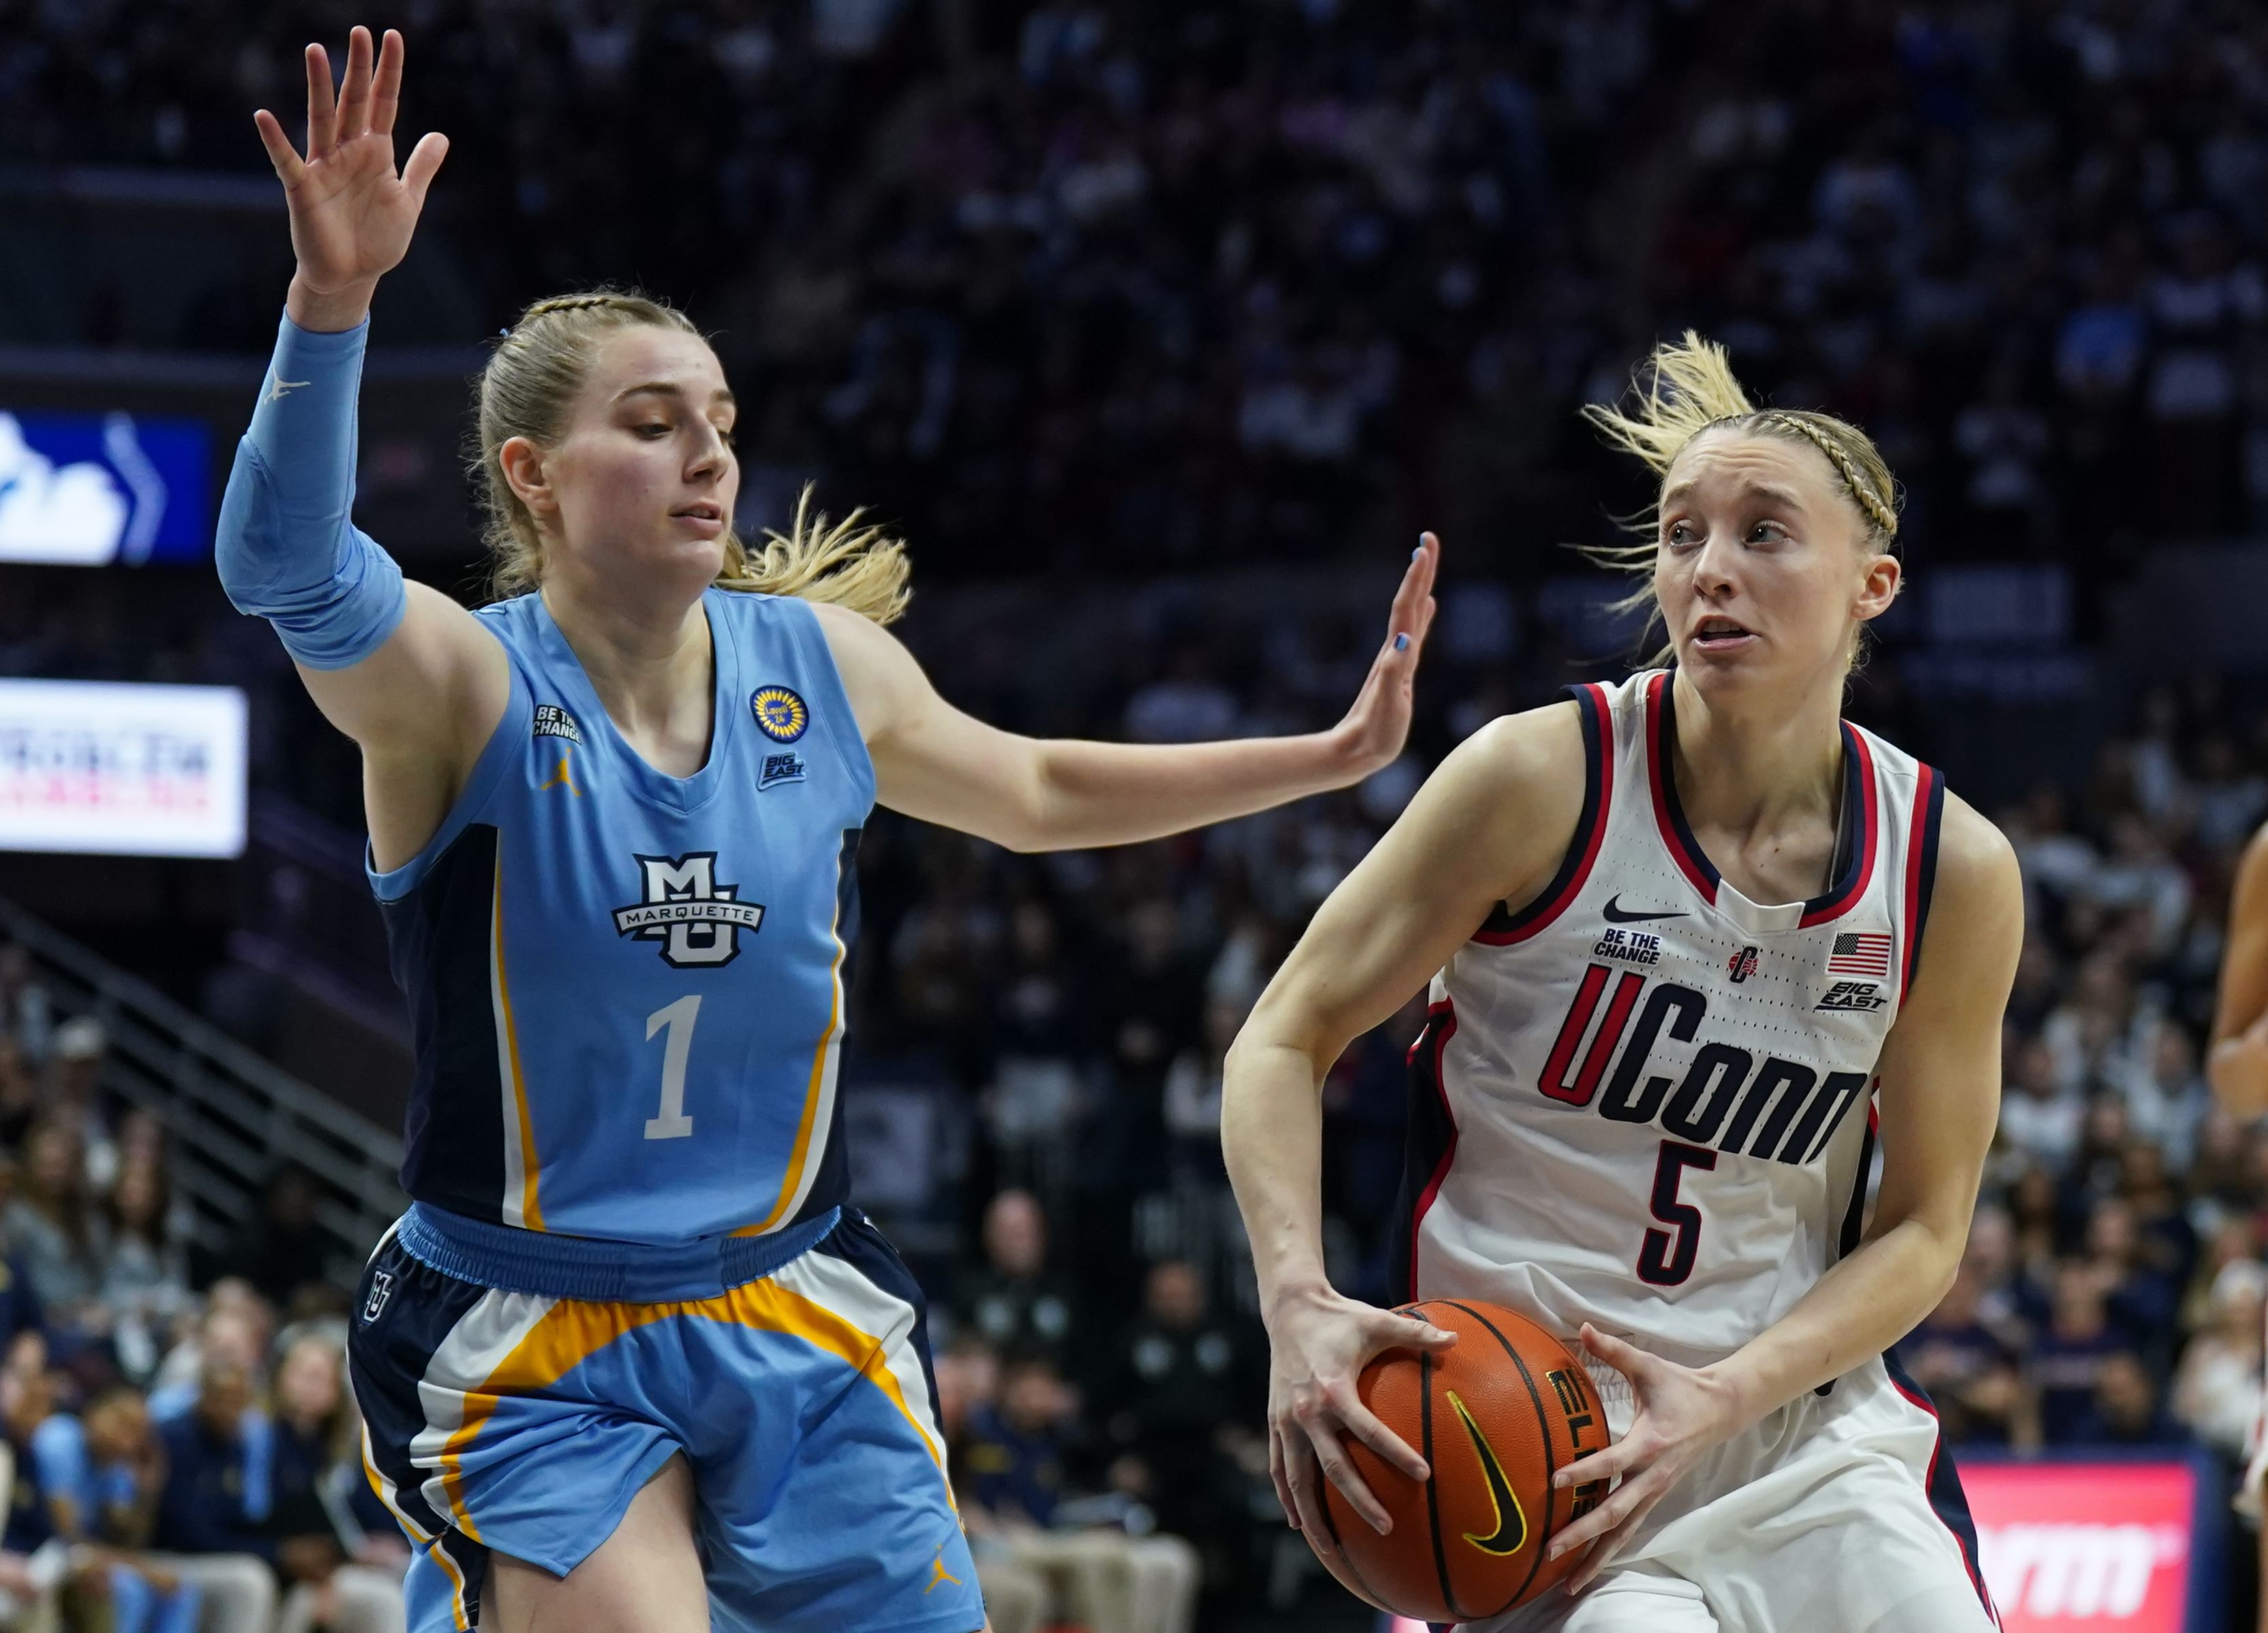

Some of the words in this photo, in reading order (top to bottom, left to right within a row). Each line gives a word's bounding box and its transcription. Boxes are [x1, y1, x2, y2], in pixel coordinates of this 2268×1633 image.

[536, 706, 558, 721] BE
[560, 710, 577, 730] TH
[763, 761, 804, 778] EAST
[766, 752, 796, 767] BIG
[625, 905, 755, 925] MARQUETTE
[1603, 928, 1627, 945] BE
[1630, 932, 1660, 951] THE
[1594, 941, 1661, 965] CHANGE
[1829, 981, 1879, 996] BIG
[1819, 992, 1888, 1009] EAST
[644, 994, 703, 1140] 1
[1537, 962, 1869, 1165] UConn
[1636, 1138, 1719, 1287] 5
[1978, 1523, 2156, 1617] rm
